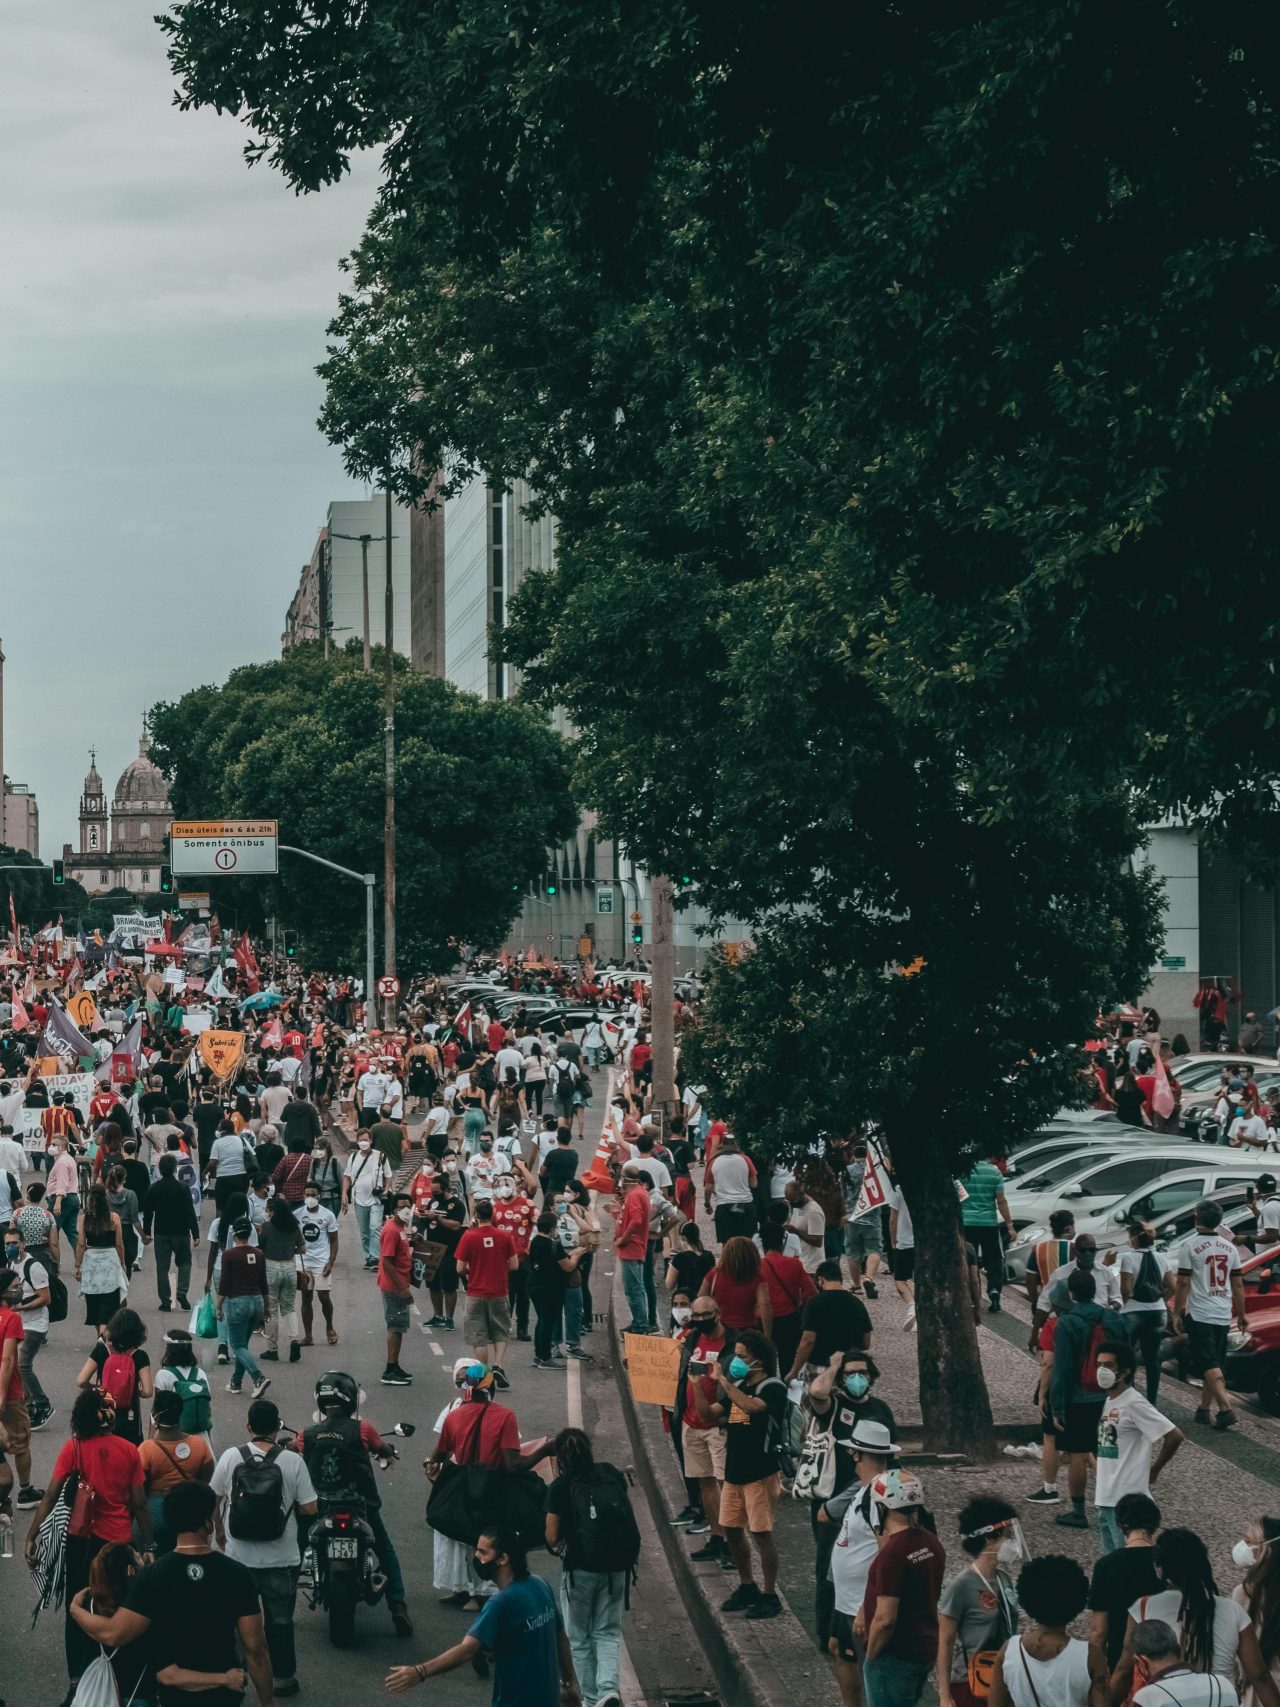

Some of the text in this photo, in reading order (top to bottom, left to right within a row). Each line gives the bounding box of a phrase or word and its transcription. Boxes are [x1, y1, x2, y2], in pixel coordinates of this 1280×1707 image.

[196, 826, 217, 834] úteis
[230, 838, 265, 846] ônibus
[291, 1036, 301, 1046] 10
[1194, 1241, 1232, 1255] BLACK LIVES
[1204, 1255, 1228, 1287] 13
